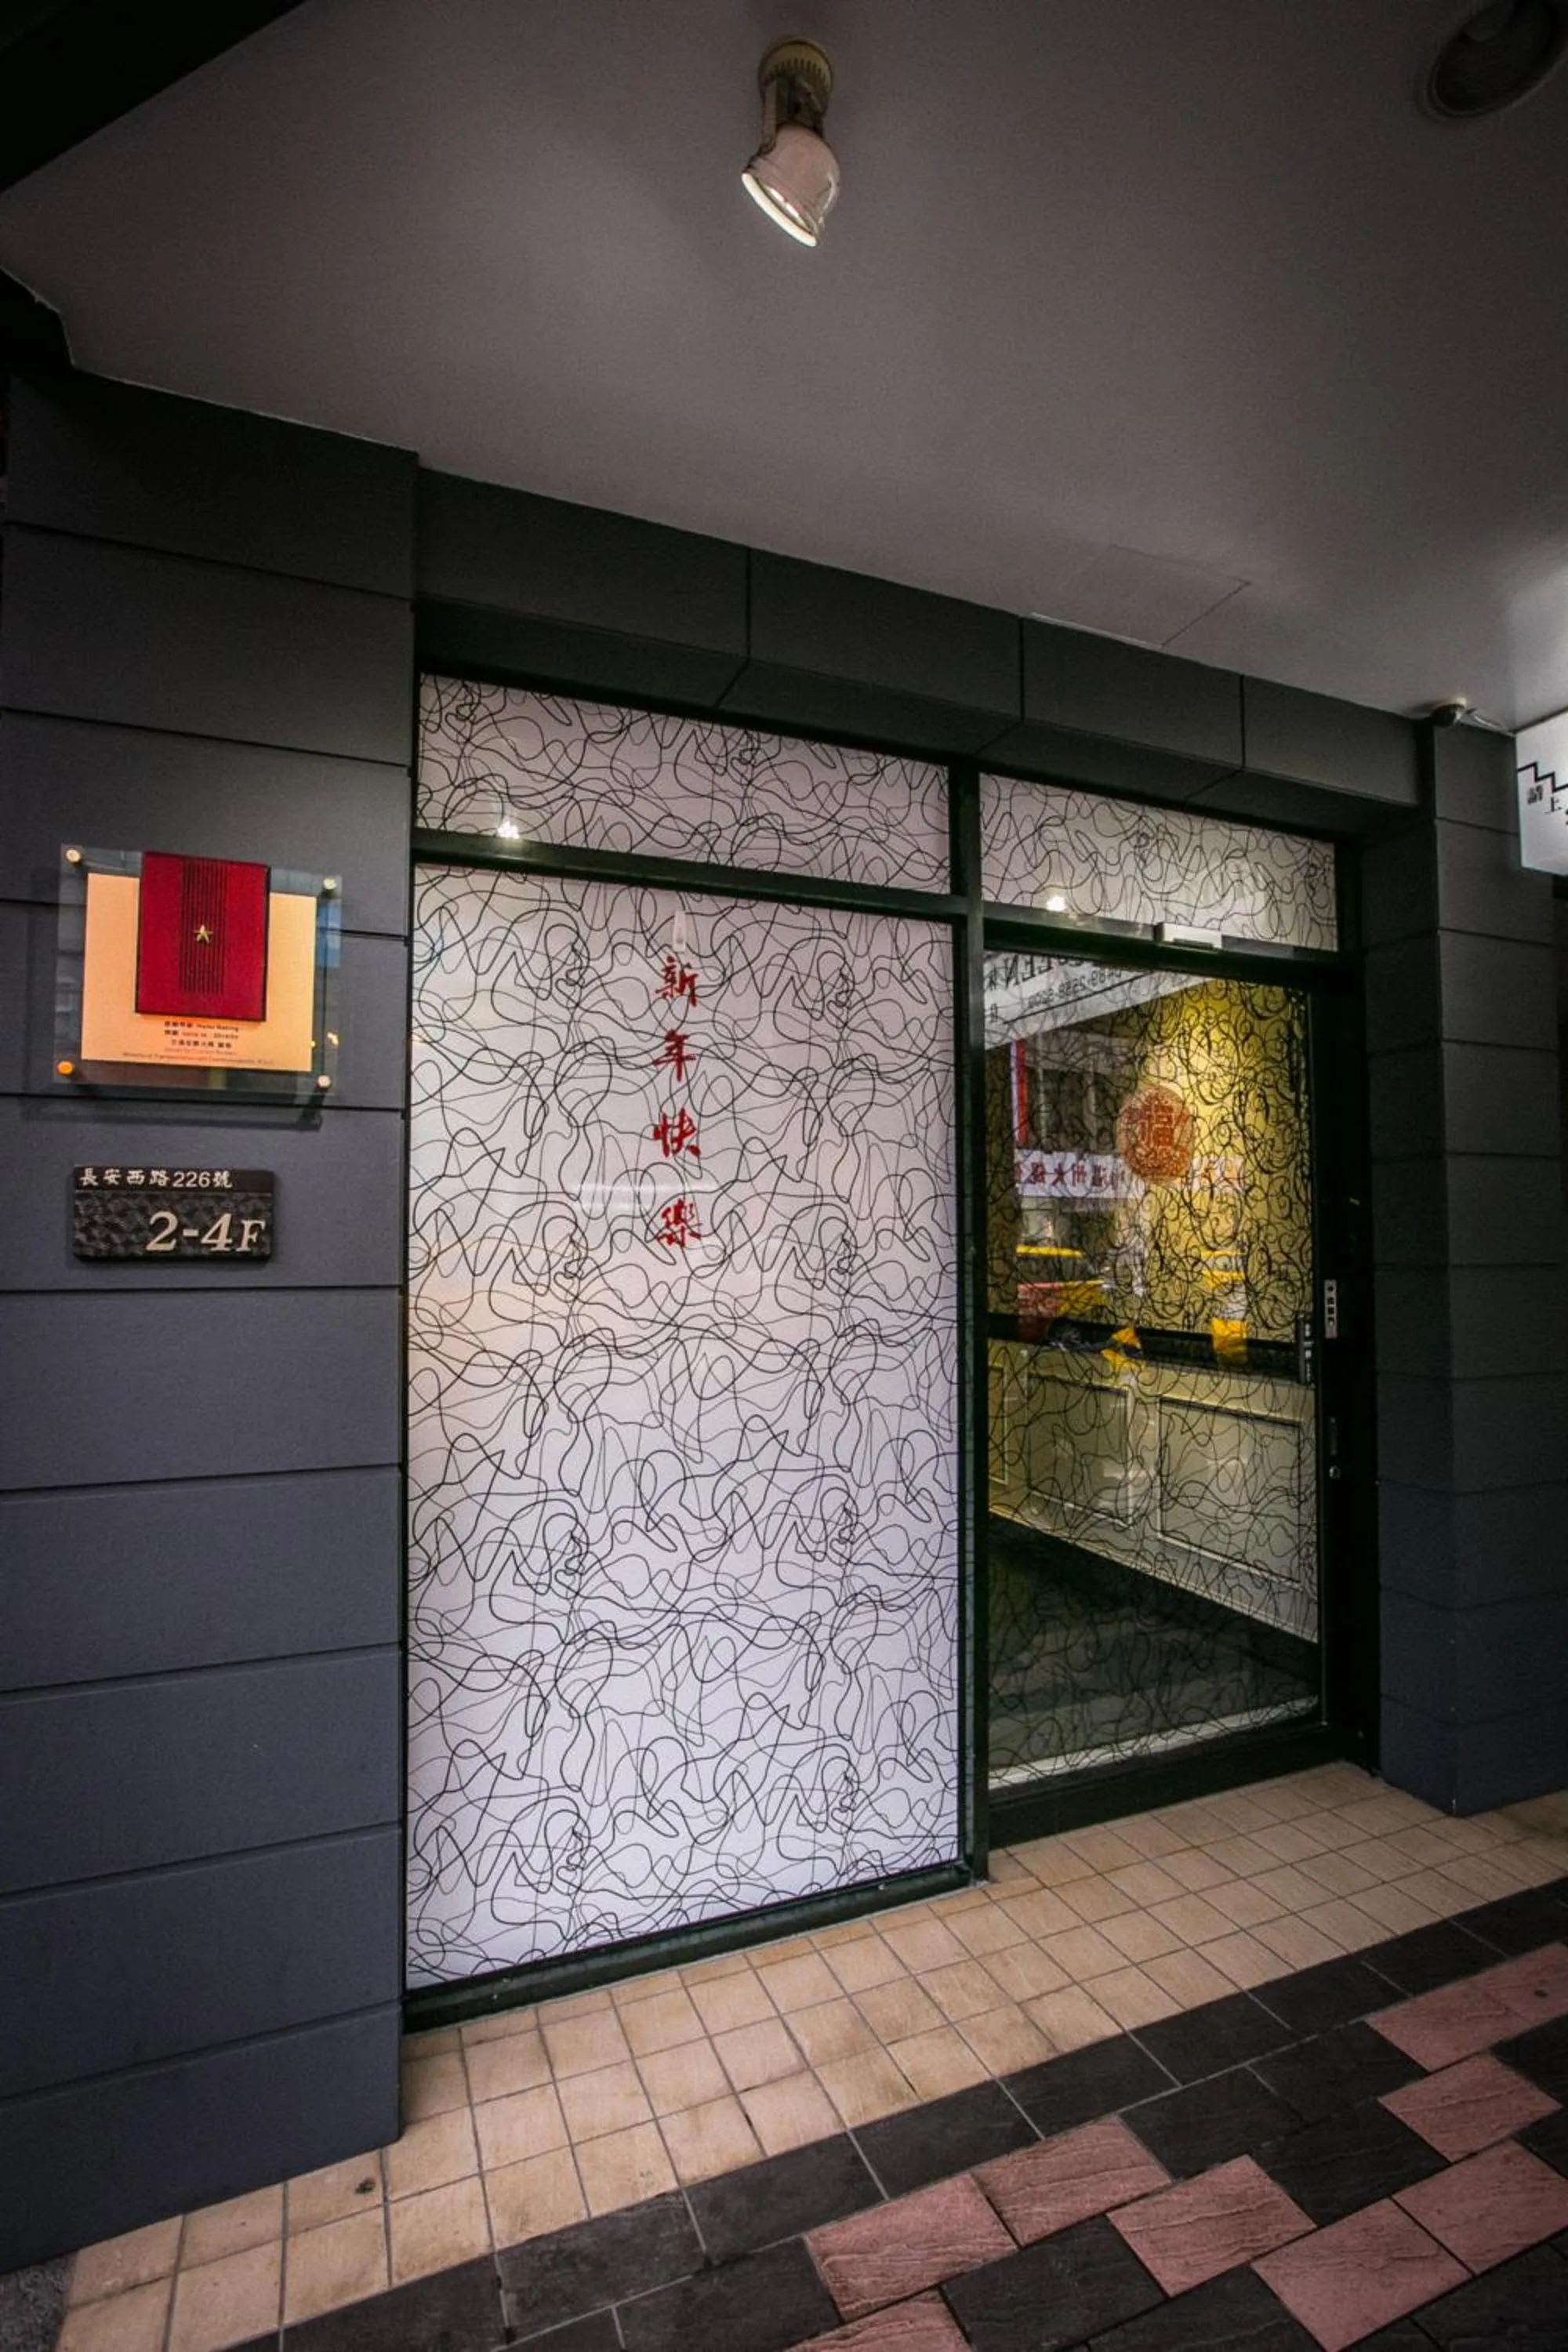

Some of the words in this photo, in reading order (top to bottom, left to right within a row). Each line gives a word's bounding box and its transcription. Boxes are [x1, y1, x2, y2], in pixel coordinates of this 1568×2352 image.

[652, 956, 702, 1248] 新年快樂
[80, 1167, 233, 1189] 長安西路226號
[146, 1210, 266, 1252] 2-4F
